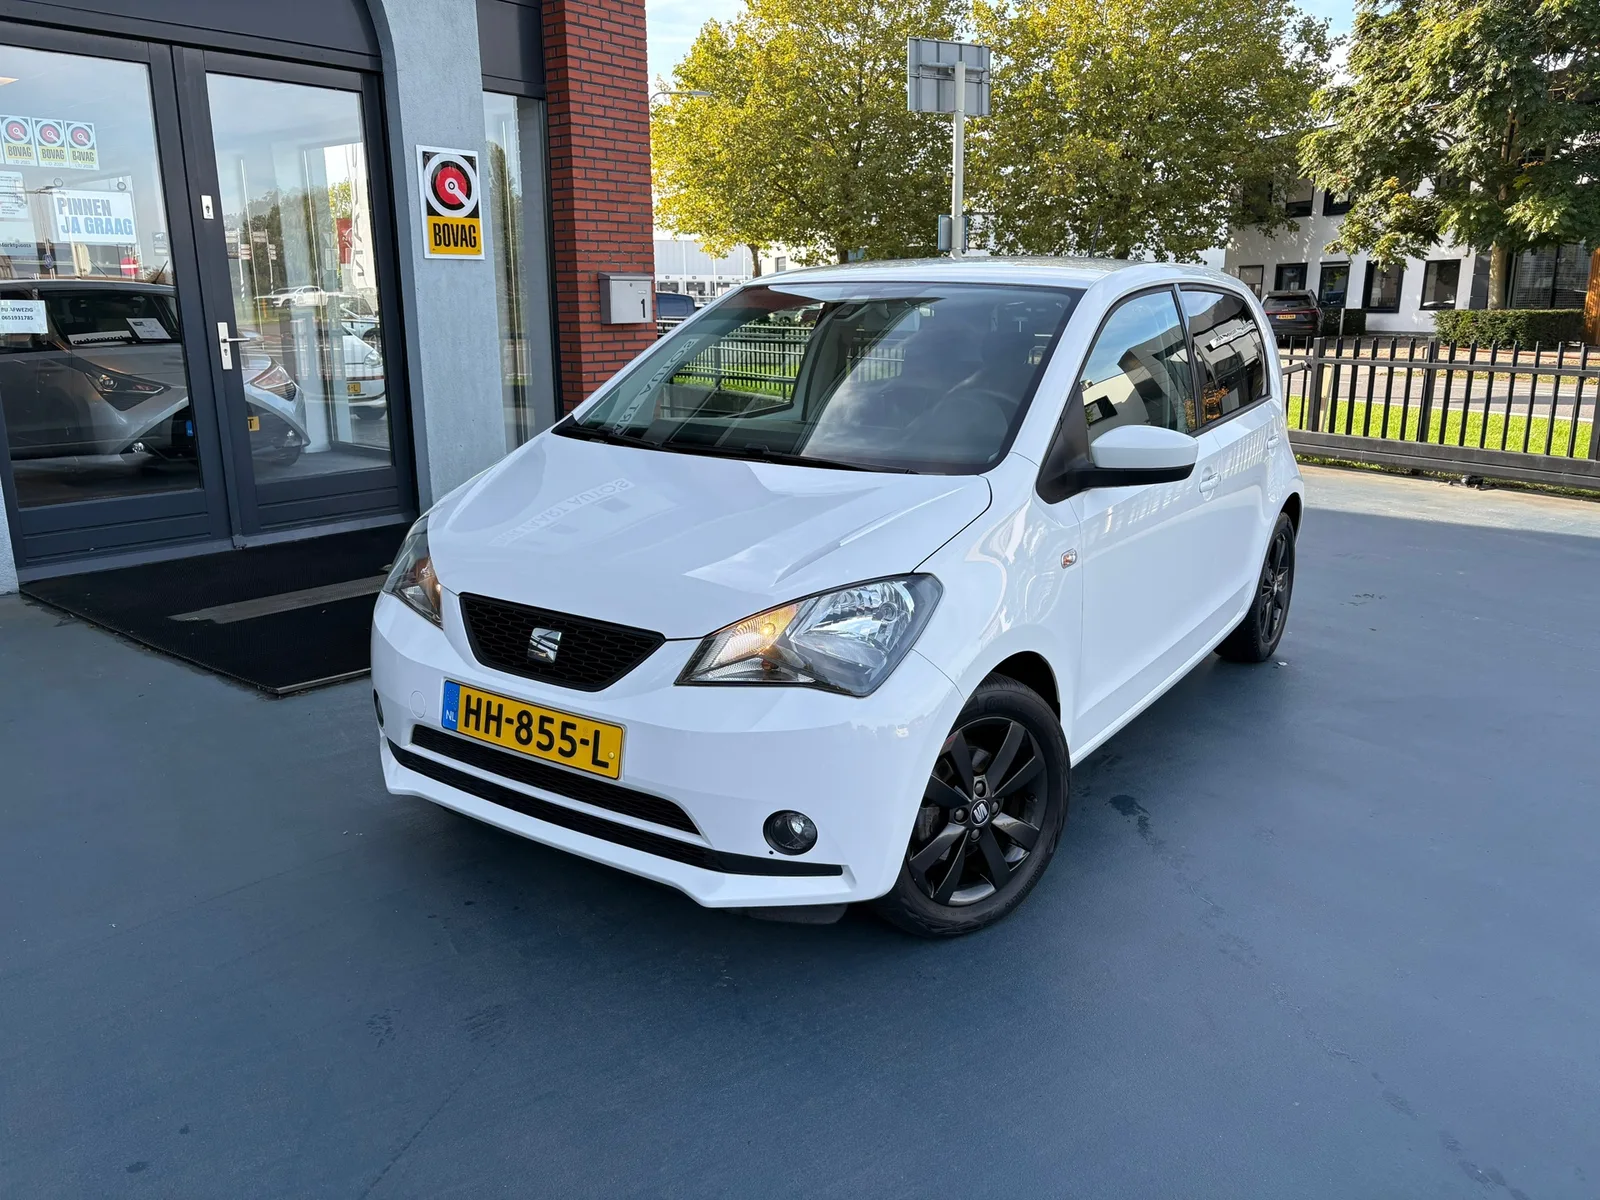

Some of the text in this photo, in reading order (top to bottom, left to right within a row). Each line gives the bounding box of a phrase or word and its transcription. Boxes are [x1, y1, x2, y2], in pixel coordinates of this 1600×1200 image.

[8, 145, 32, 157] BOVAG
[42, 148, 65, 160] BOVAG
[72, 150, 95, 162] BOVAG
[57, 197, 112, 217] PINNEN
[61, 217, 133, 235] JA GRAAG
[433, 222, 477, 248] BOVAG
[640, 298, 646, 318] 1
[445, 709, 456, 723] NL
[464, 694, 609, 769] HH-855-L
